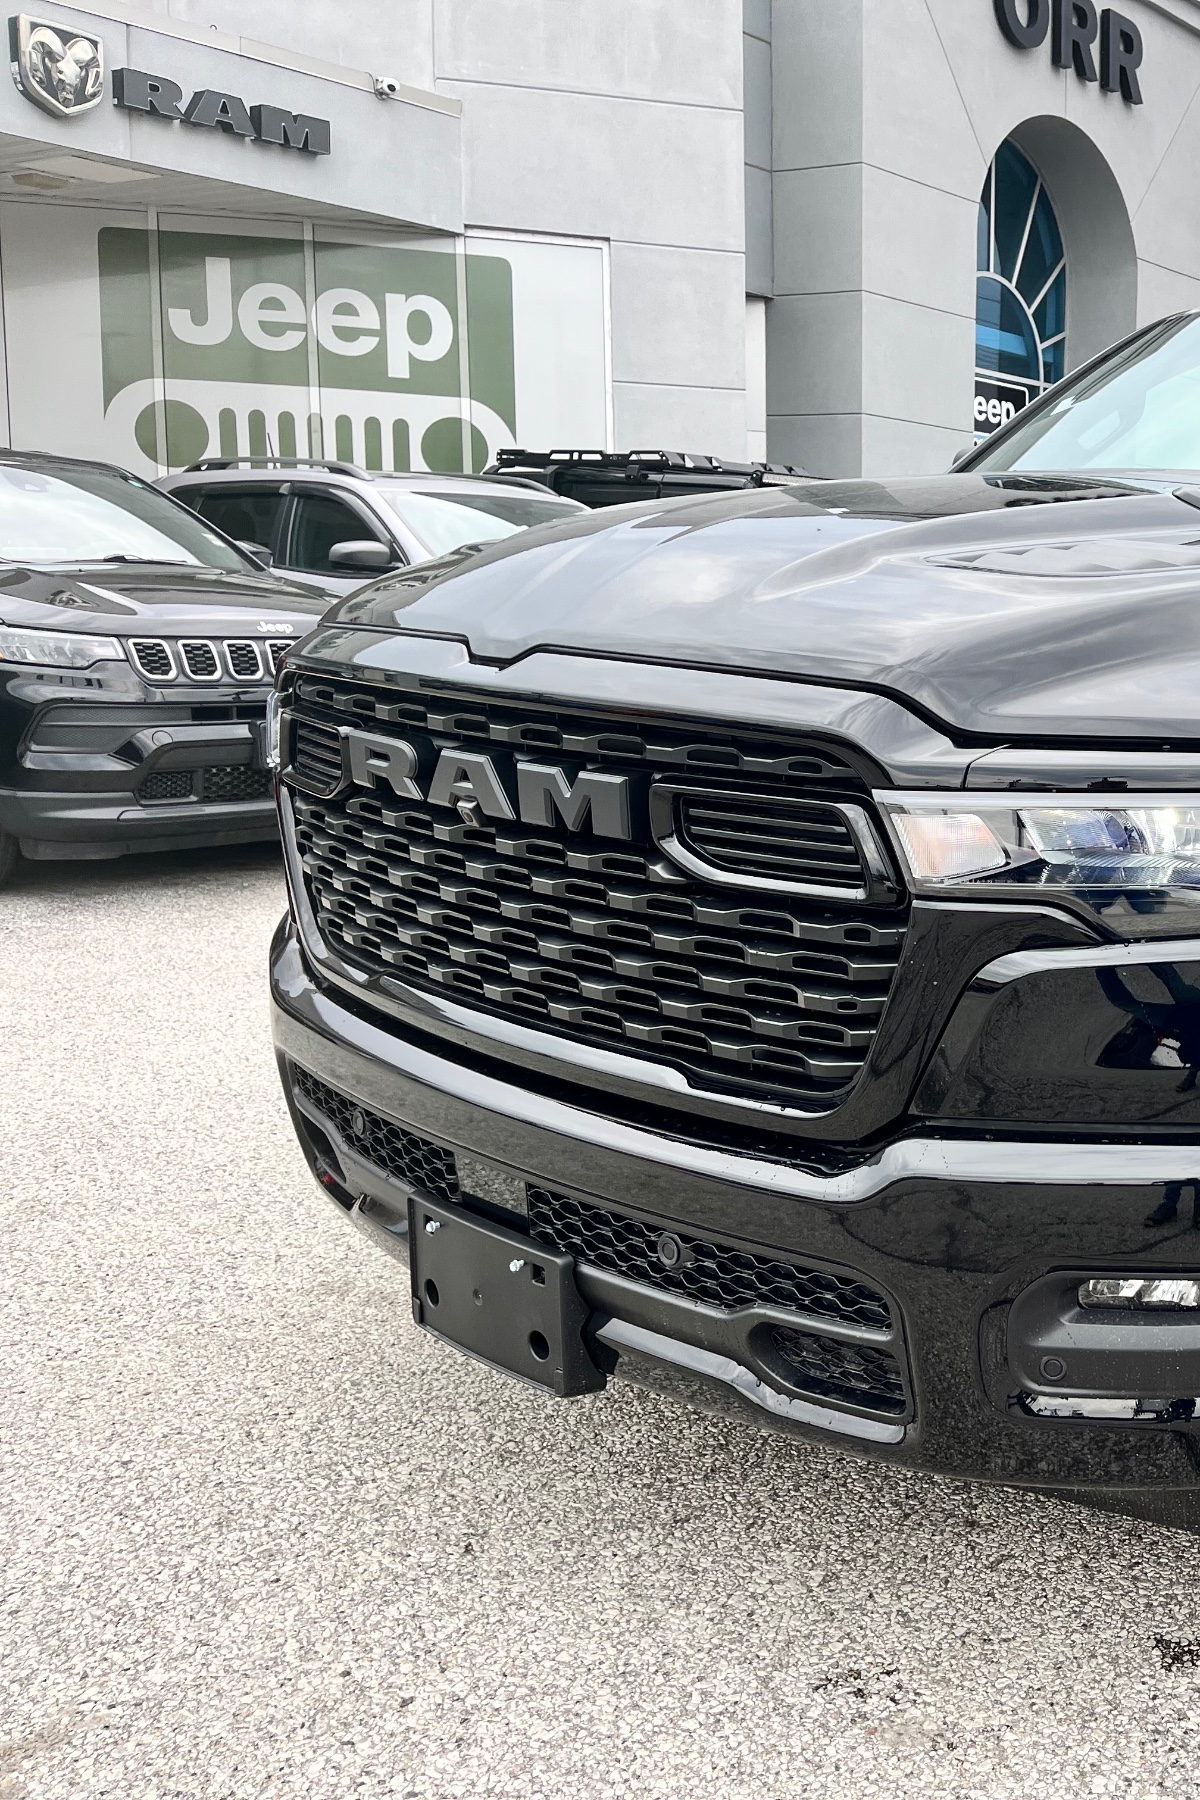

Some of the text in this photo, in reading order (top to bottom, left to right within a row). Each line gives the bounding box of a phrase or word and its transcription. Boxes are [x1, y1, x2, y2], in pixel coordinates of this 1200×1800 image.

[112, 67, 330, 156] RAM
[168, 257, 454, 379] Jeep
[974, 395, 1016, 427] eep
[257, 621, 293, 633] Jeep
[347, 728, 634, 840] RAM
